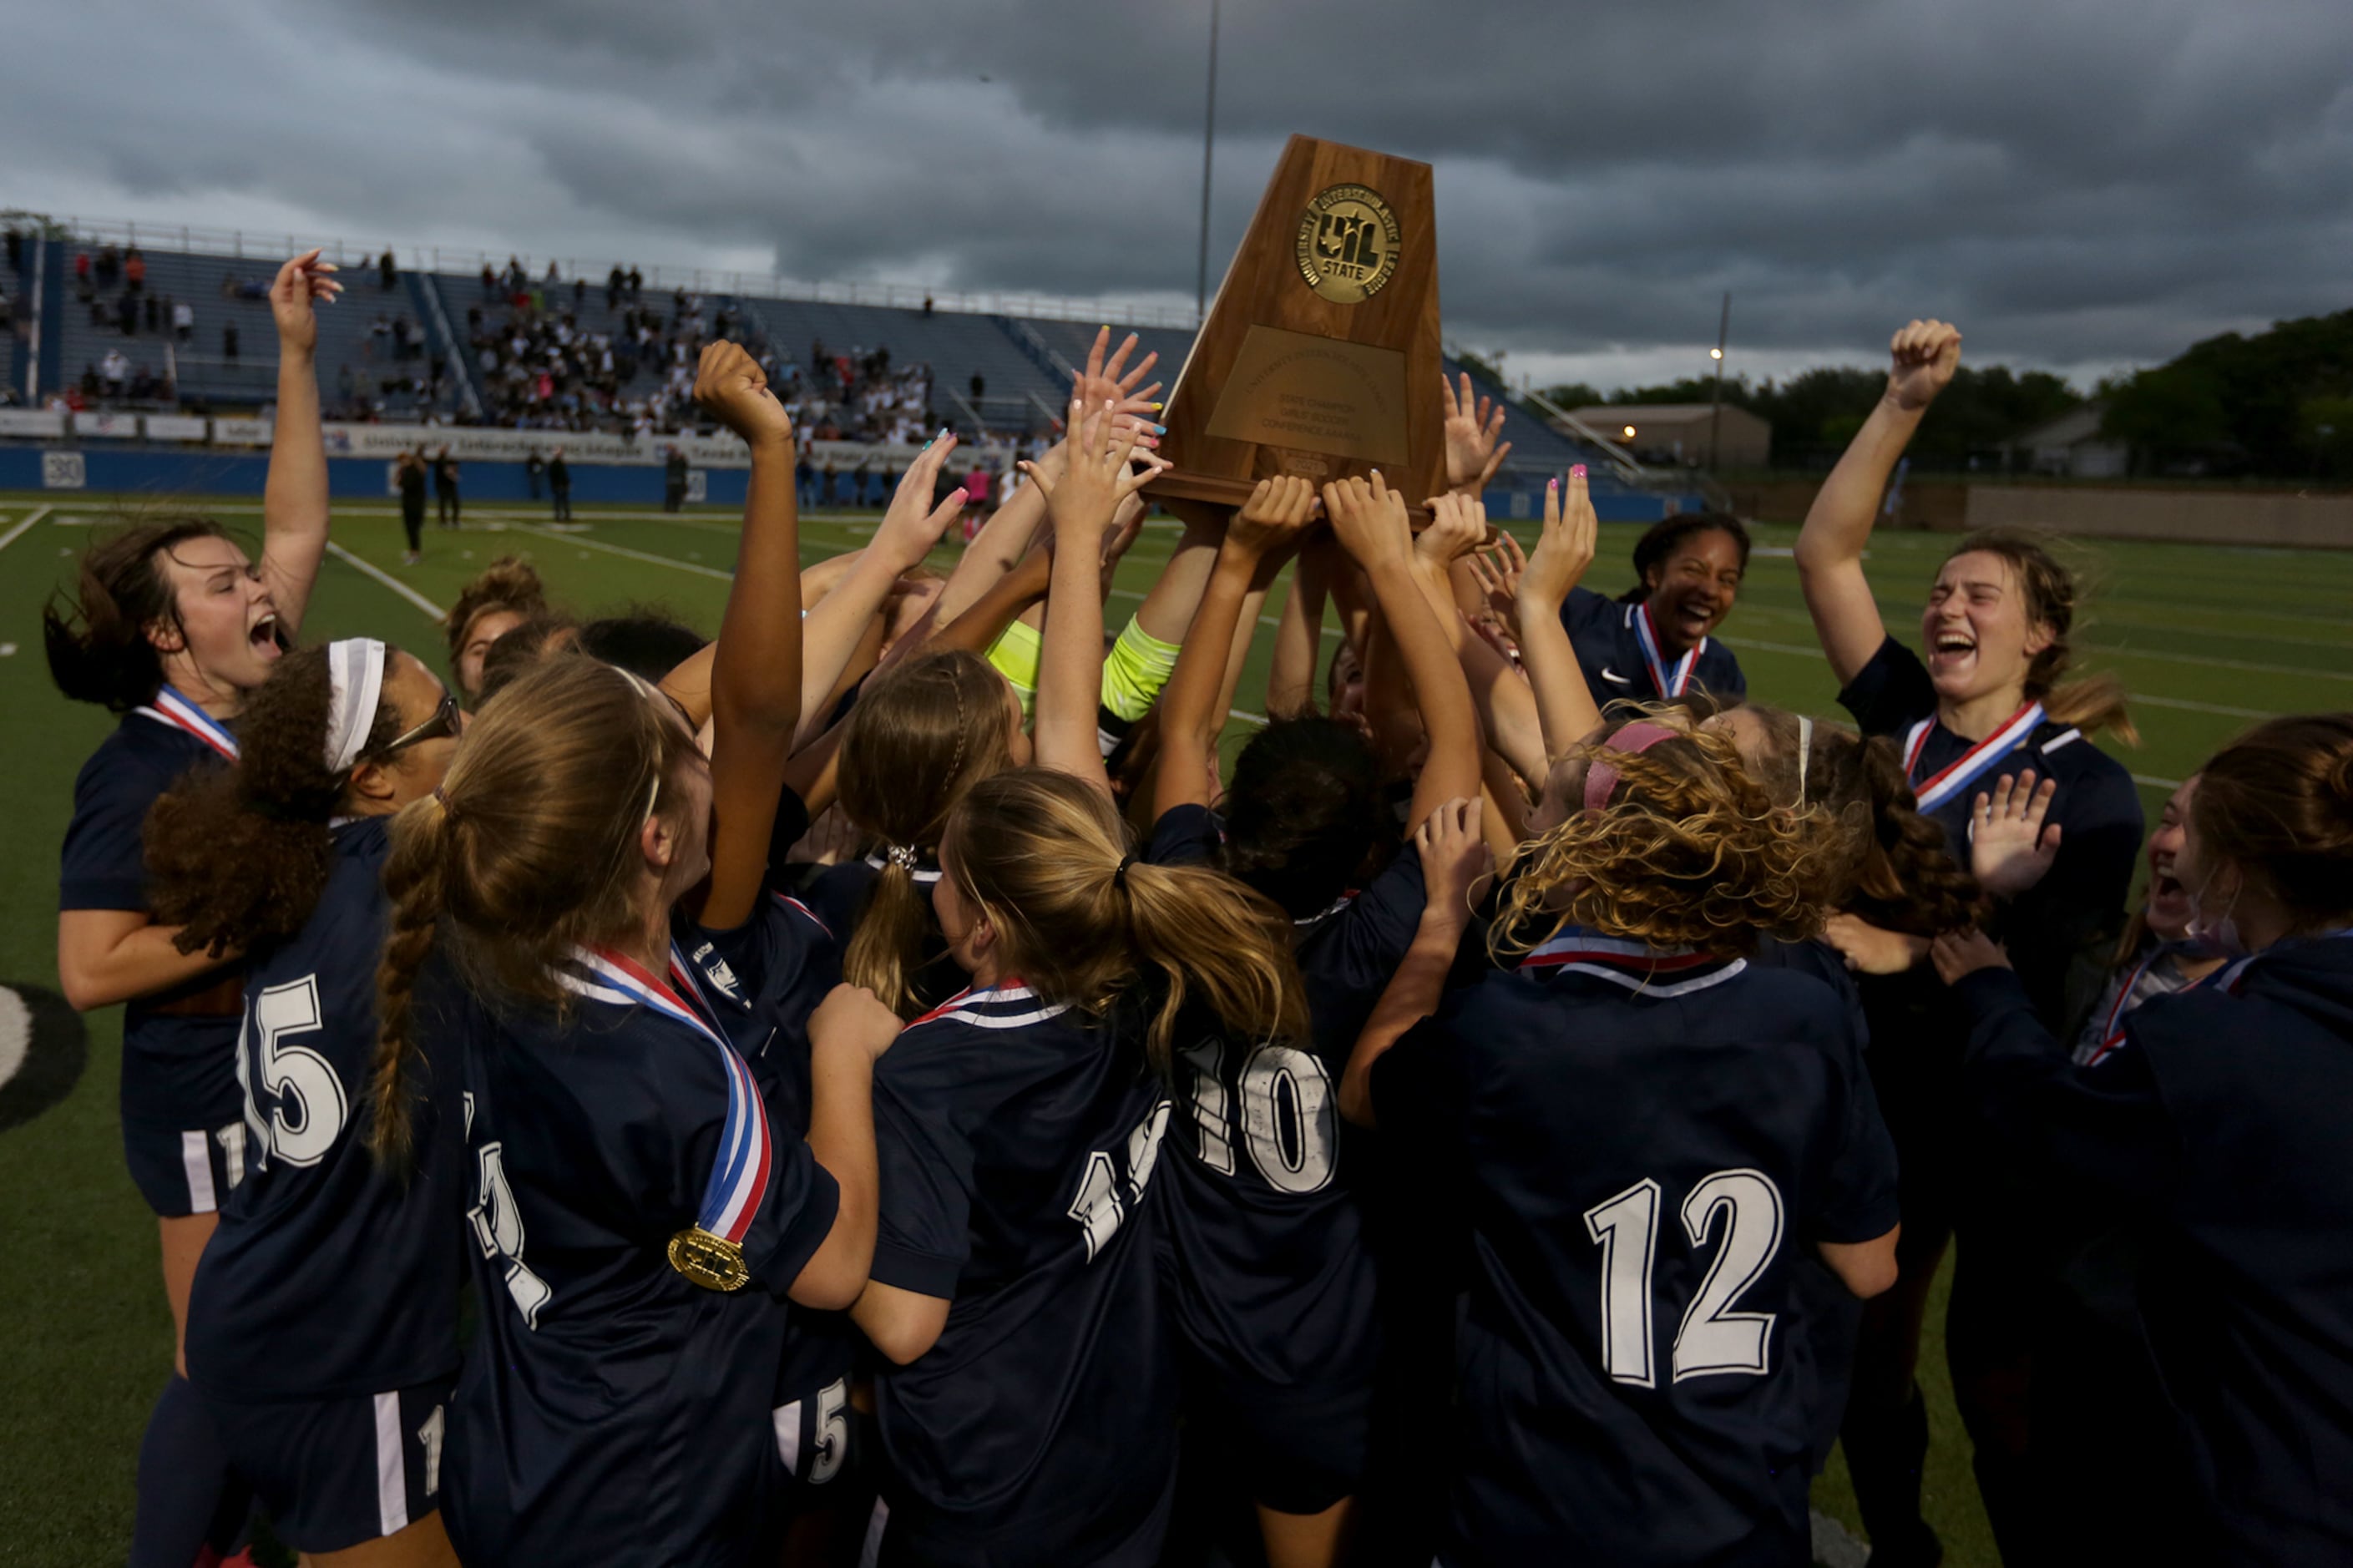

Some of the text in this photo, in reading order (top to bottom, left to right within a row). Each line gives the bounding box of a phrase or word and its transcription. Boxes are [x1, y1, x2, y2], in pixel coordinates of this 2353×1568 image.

[1323, 260, 1364, 281] STATE
[1176, 1033, 1340, 1196] 10
[1583, 1167, 1784, 1389] 12
[807, 1376, 848, 1485] 5
